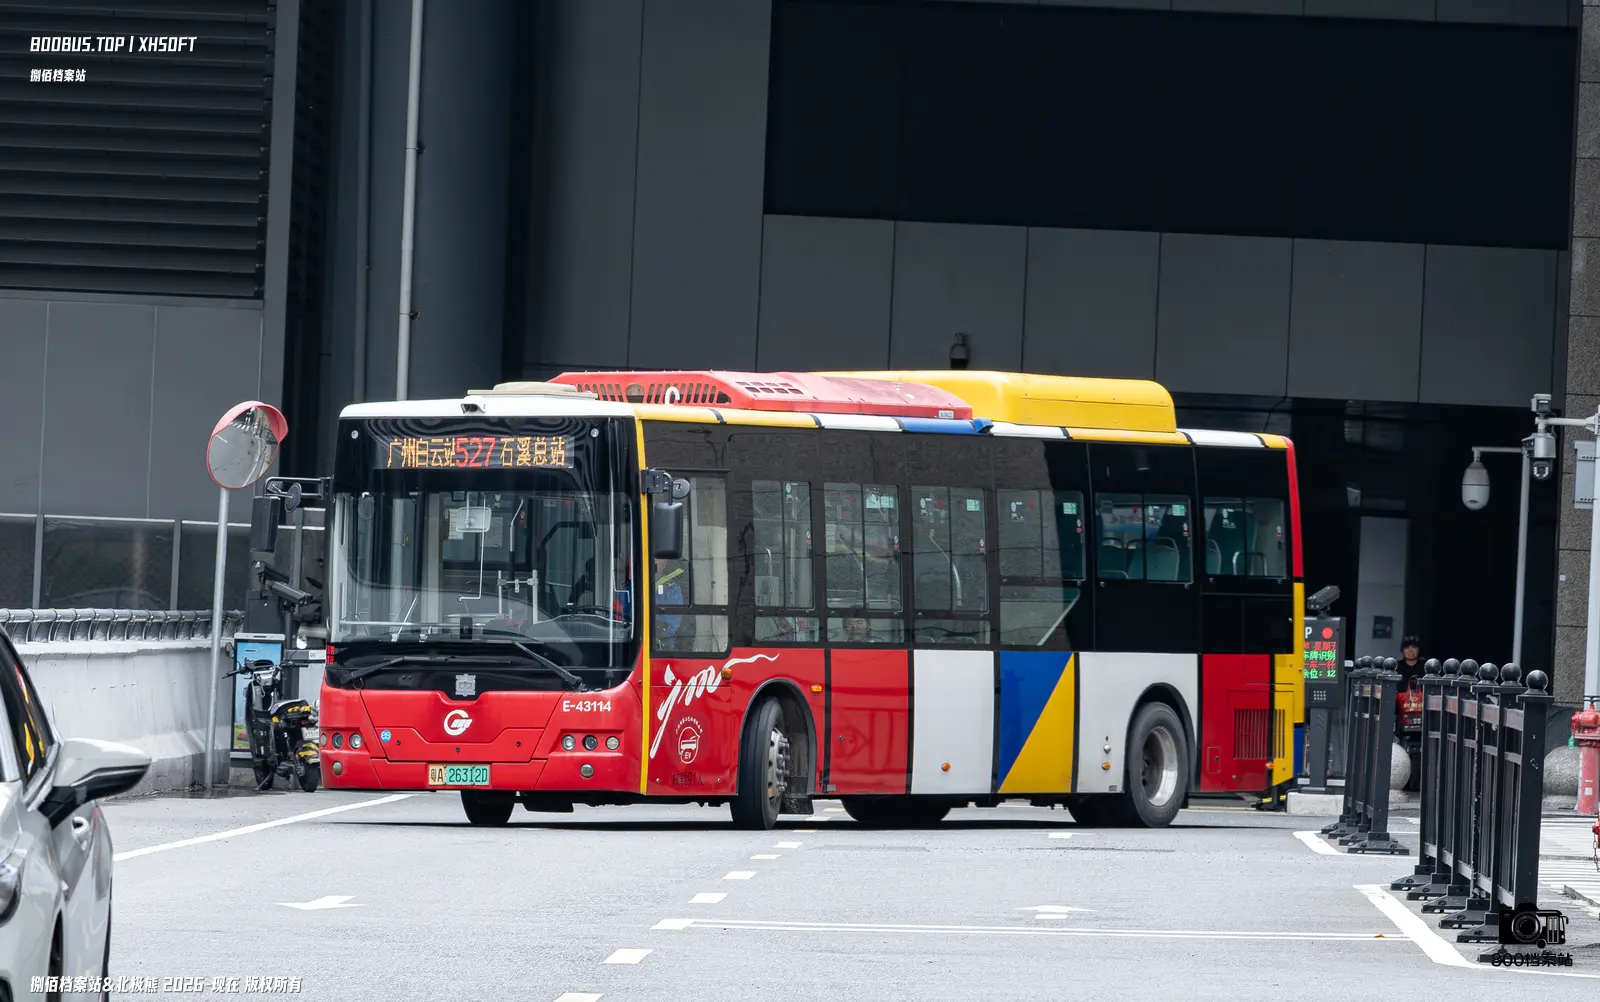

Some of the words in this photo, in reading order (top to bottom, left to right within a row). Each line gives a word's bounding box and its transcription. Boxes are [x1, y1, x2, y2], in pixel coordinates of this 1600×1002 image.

[456, 436, 496, 467] 527
[500, 437, 565, 467] 石溪总站
[1305, 626, 1312, 639] P
[562, 701, 612, 712] E-43114
